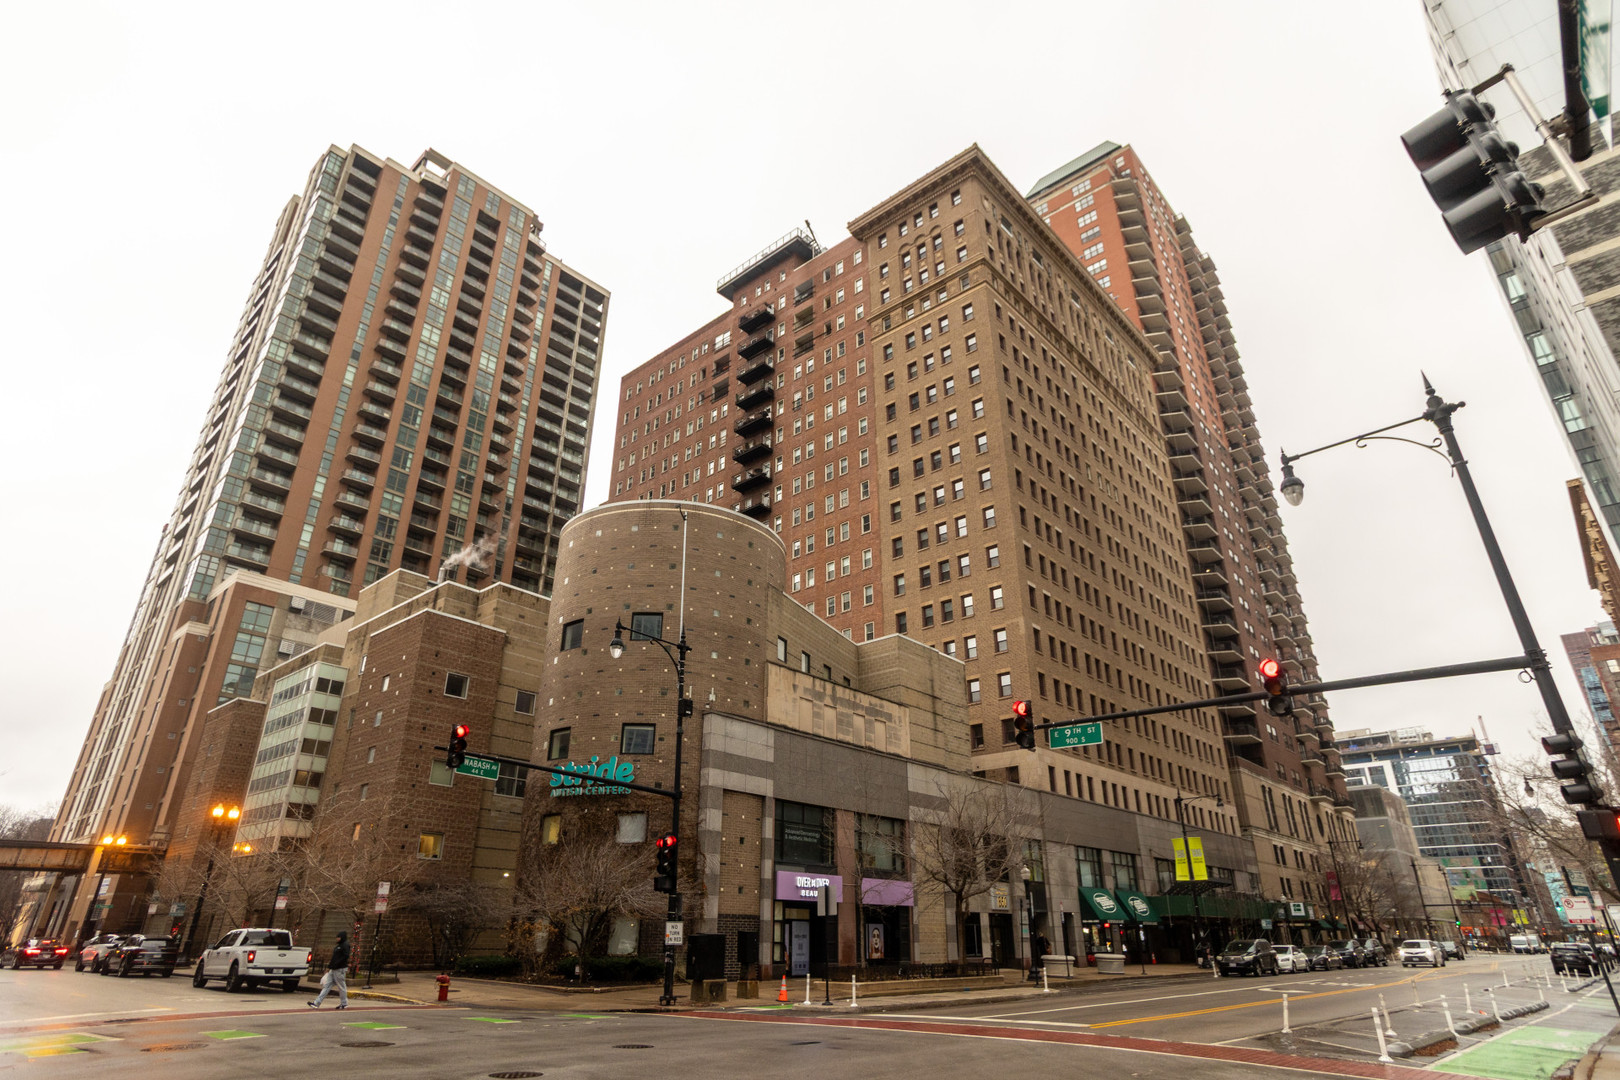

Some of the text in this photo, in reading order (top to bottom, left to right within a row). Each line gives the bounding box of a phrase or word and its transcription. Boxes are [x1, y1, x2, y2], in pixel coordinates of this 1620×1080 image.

[1065, 728, 1081, 737] 9TH
[549, 755, 635, 787] stride
[549, 785, 632, 798] AUTISM CENTERS
